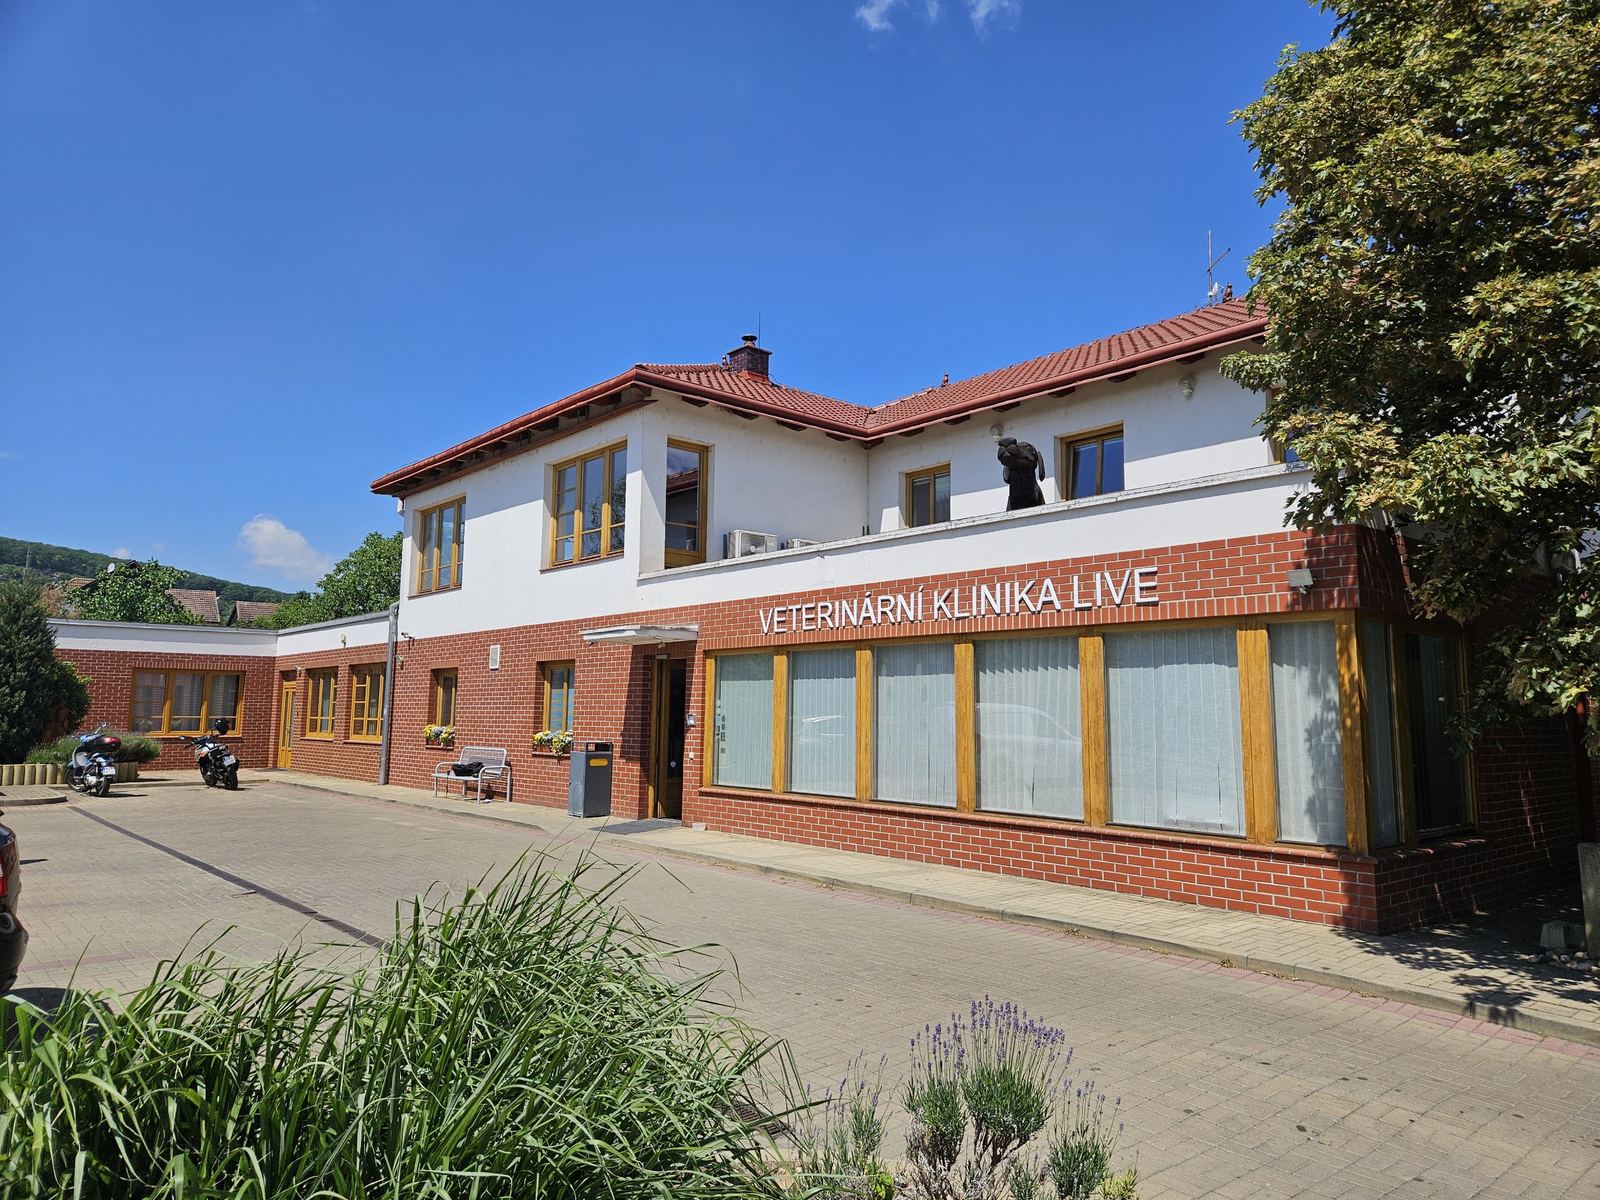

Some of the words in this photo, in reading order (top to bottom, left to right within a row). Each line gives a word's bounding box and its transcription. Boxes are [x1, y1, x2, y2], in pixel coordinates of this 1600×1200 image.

[759, 585, 924, 634] VETERINÁRNÍ
[933, 578, 1061, 621] KLINIKA
[1073, 567, 1159, 609] LIVE
